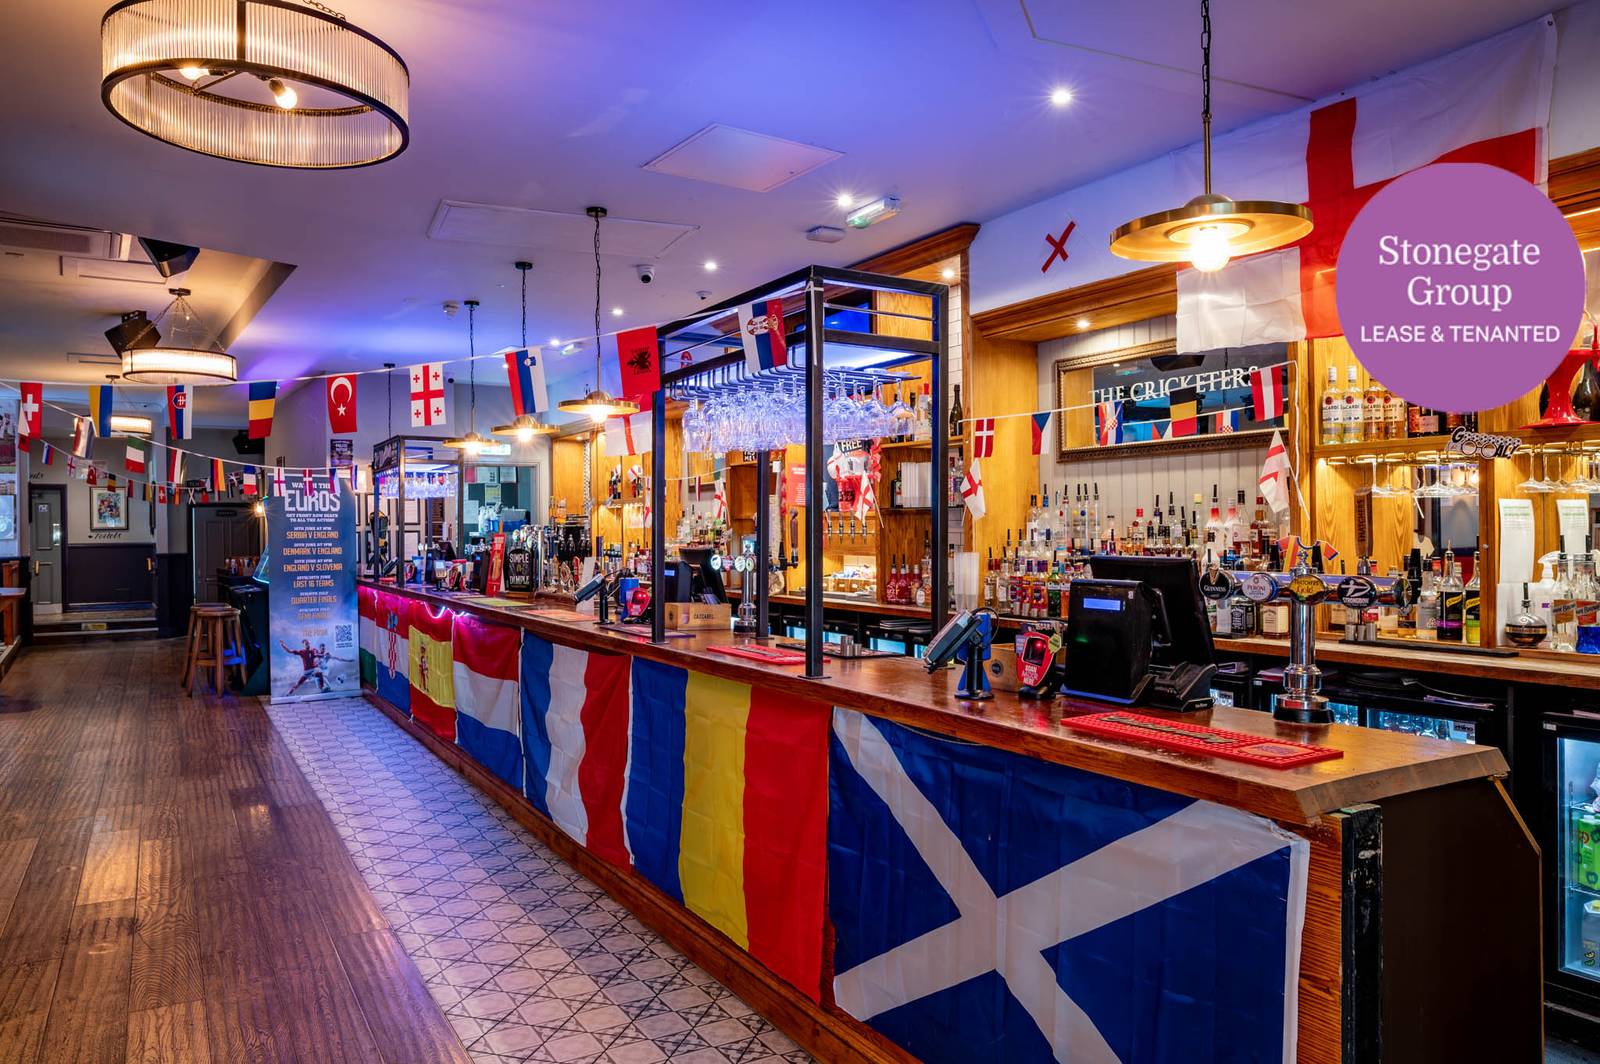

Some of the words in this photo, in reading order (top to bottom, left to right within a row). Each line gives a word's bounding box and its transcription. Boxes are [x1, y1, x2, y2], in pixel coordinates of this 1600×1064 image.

[1089, 386, 1125, 406] THE
[1129, 365, 1260, 402] CRICKETERS
[841, 440, 862, 452] FREE
[284, 489, 341, 512] EUROS
[286, 531, 307, 539] SERBIA
[307, 531, 313, 539] V
[313, 531, 339, 539] ENGLAND
[283, 547, 310, 556] DENMARK
[311, 547, 317, 555] V
[317, 547, 342, 555] ENGLAND
[509, 553, 530, 563] SIMPLE
[283, 563, 309, 572] ENGLAND
[310, 563, 315, 571] V
[315, 562, 342, 571] SLOVENIA
[293, 580, 306, 589] LAST
[308, 580, 315, 588] 16
[316, 580, 335, 588] TEAMS
[509, 575, 530, 585] DIMPLE
